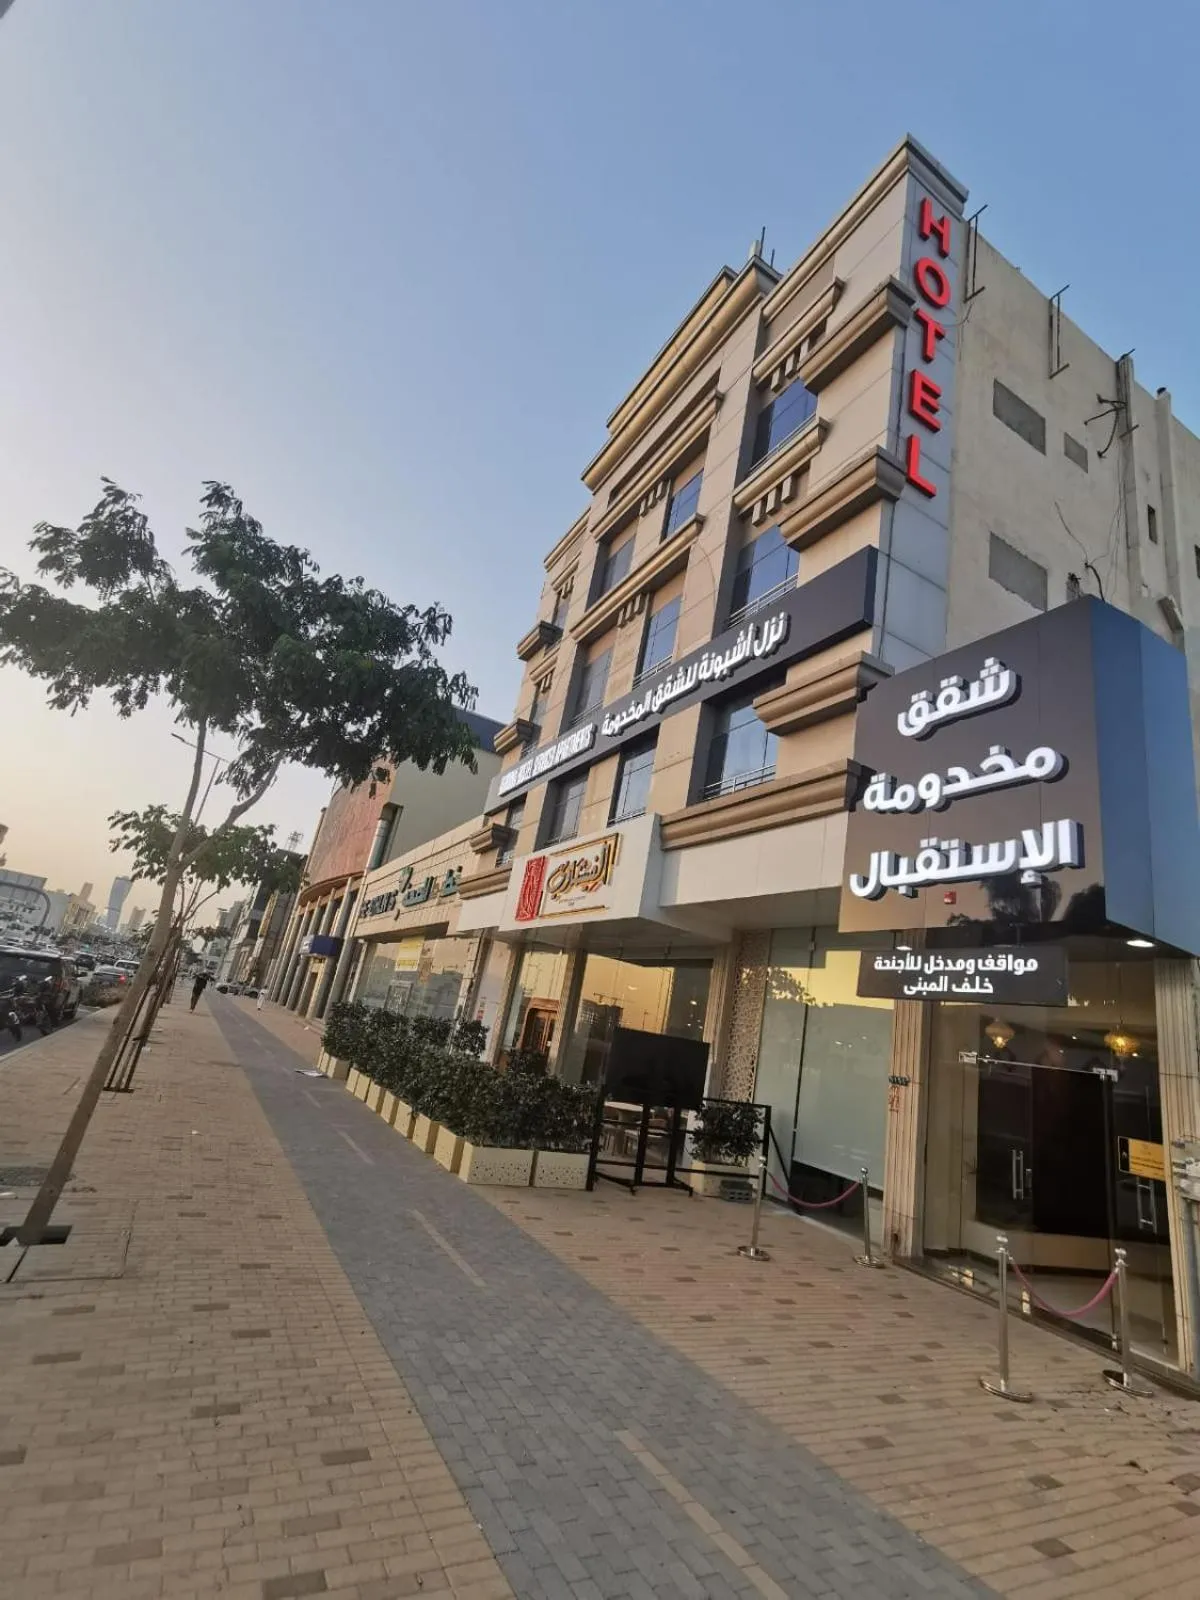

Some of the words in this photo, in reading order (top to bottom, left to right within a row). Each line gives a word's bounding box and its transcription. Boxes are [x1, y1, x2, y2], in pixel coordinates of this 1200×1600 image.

[906, 196, 951, 498] HOTEL
[753, 611, 786, 657] نزل
[651, 662, 699, 713] للشقق
[897, 656, 1020, 738] شقق
[601, 688, 652, 736] المخدومة
[863, 745, 1065, 813] مخدومة
[849, 818, 1082, 898] الإستقبال
[873, 955, 923, 975] للأجنحة
[903, 976, 950, 997] المبنى
[924, 954, 976, 976] ومدخل
[952, 976, 994, 995] خلف
[977, 953, 1039, 976] مواقف
